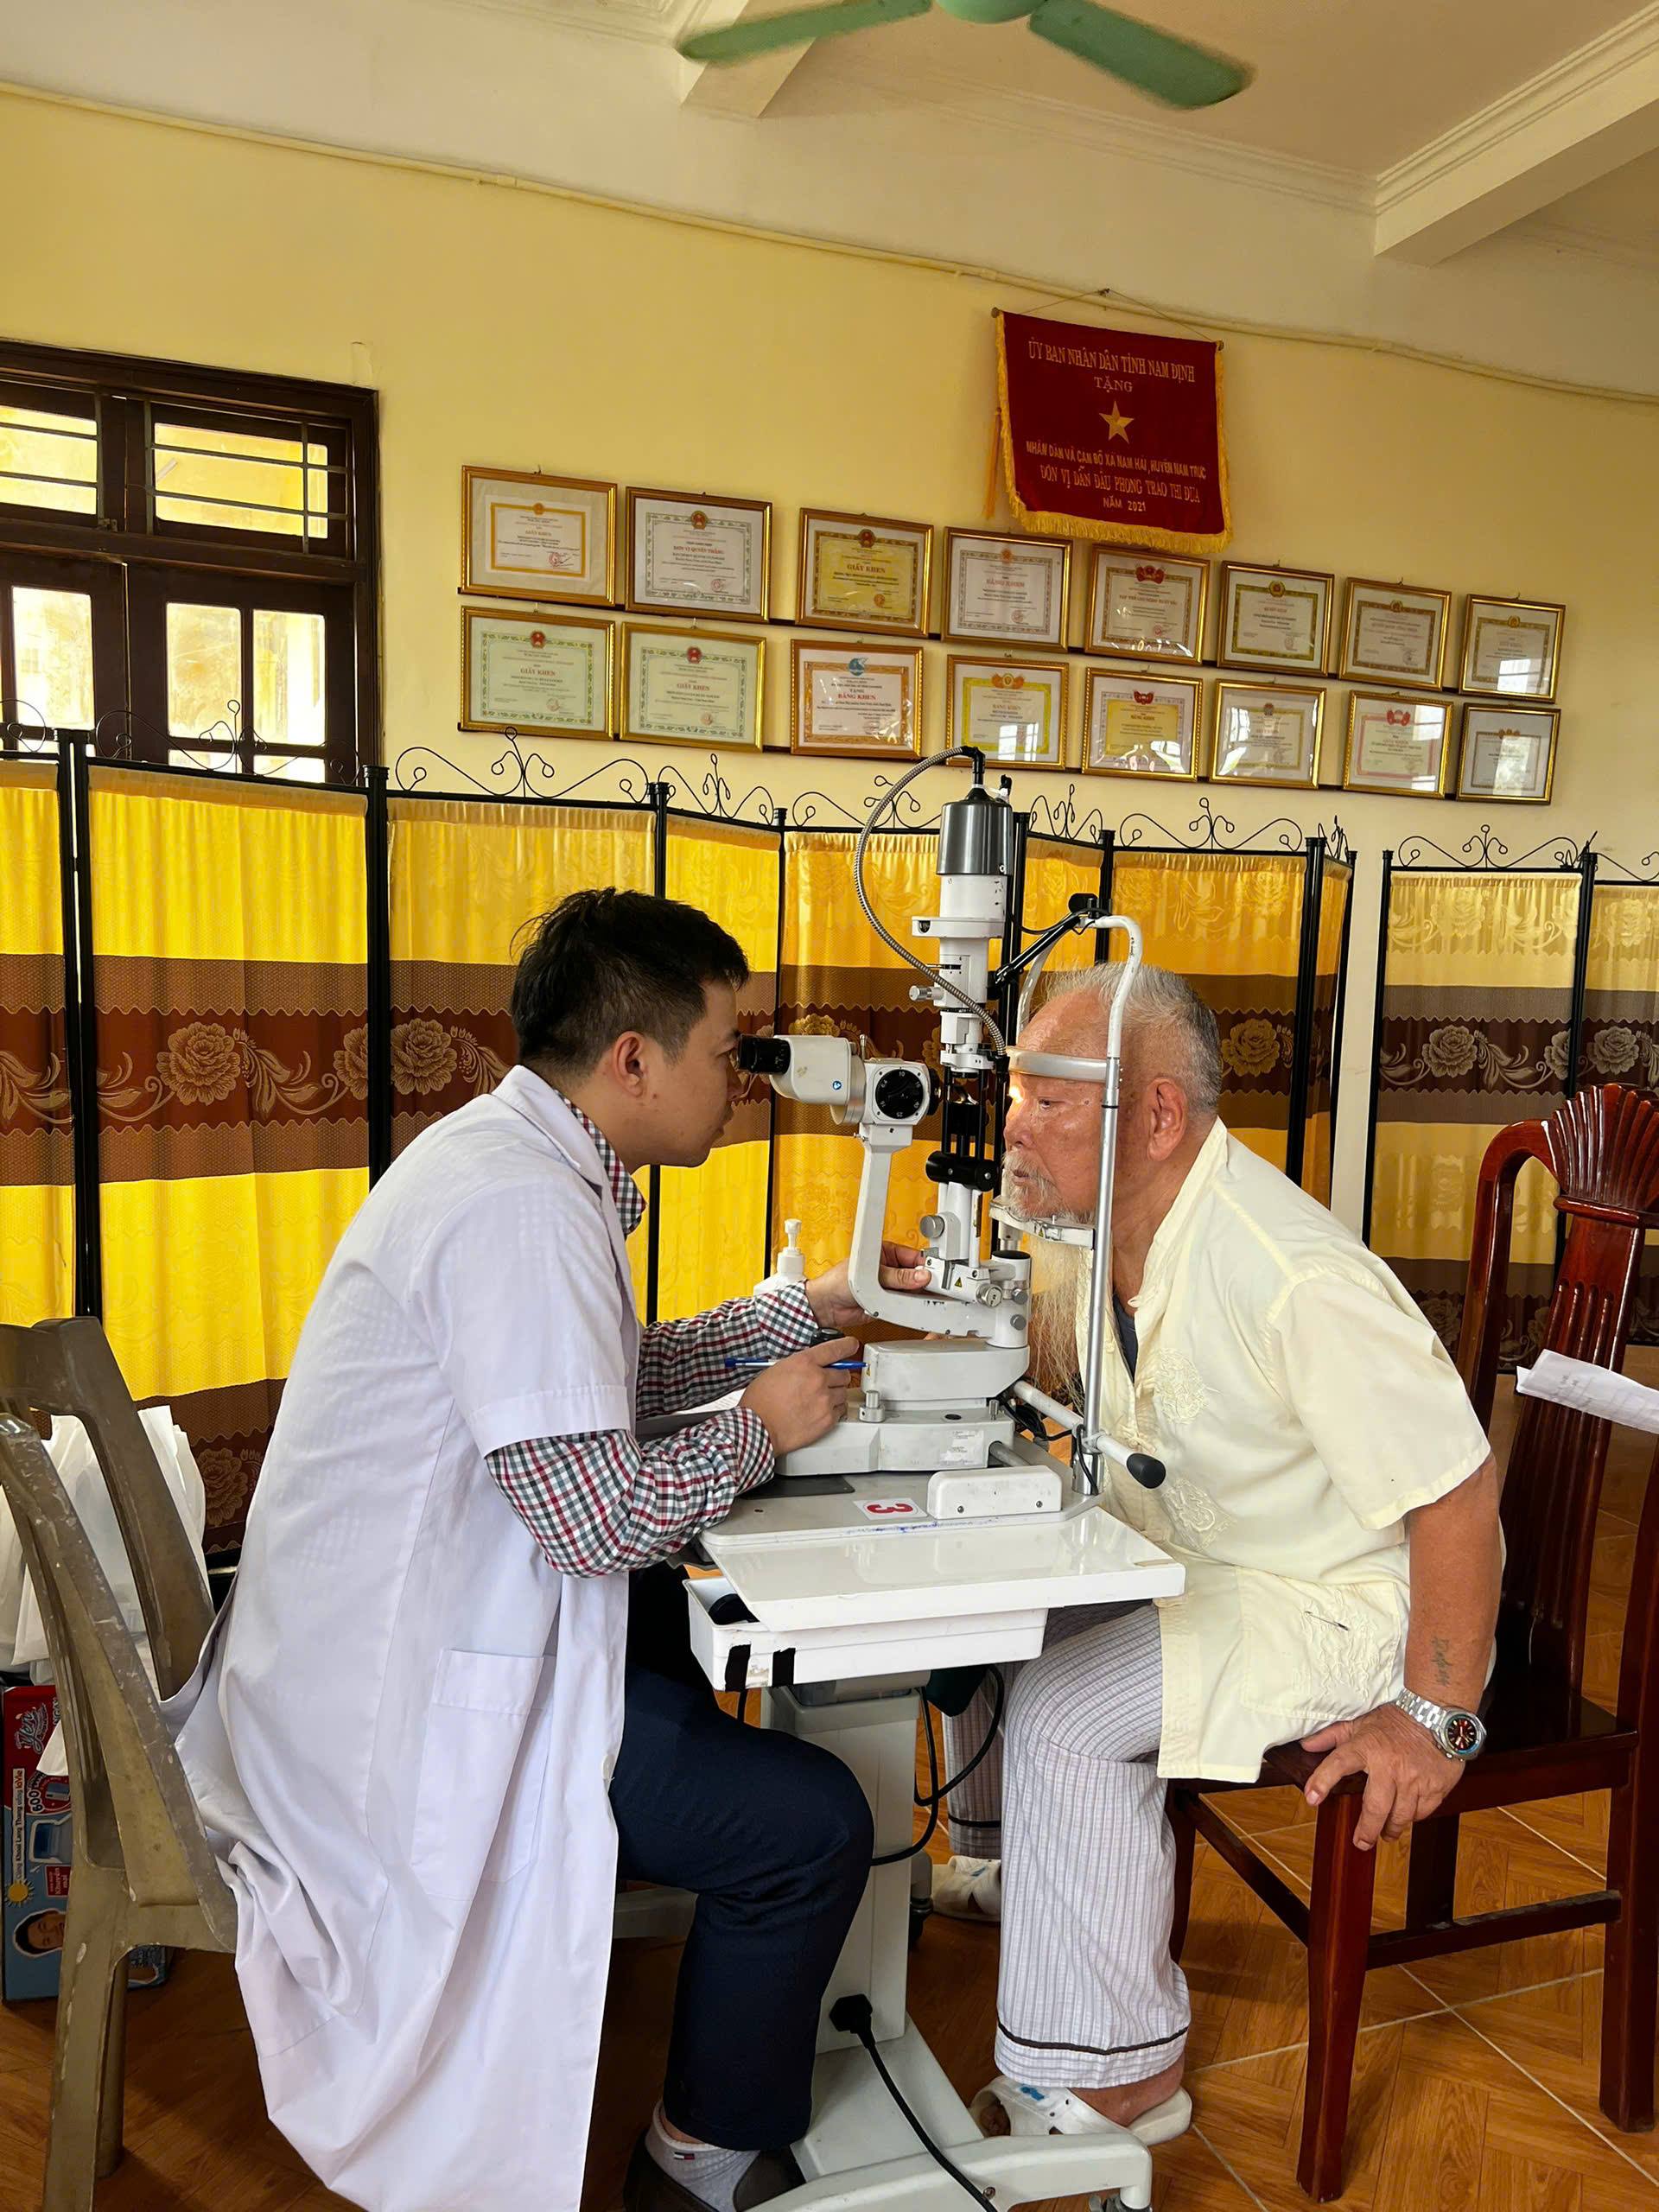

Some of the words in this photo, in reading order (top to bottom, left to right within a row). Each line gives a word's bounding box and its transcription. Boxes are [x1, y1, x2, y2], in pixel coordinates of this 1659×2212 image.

[1045, 344, 1065, 364] BAN
[1067, 346, 1096, 368] NHÂN
[1097, 349, 1119, 372] DÂN
[1147, 359, 1169, 378] NAM
[1171, 363, 1195, 384] ĐỊNH
[1093, 375, 1133, 393] TẶNG
[1060, 468, 1071, 489] VỊ
[1114, 476, 1142, 495] PHONG
[1169, 483, 1183, 499] THI
[1103, 495, 1123, 509] NĂM
[1128, 500, 1147, 512] 2021
[867, 1503, 913, 1514] 3
[29, 1790, 43, 1812] 600
[15, 1806, 23, 1825] Thang
[15, 1826, 23, 1842] Lang
